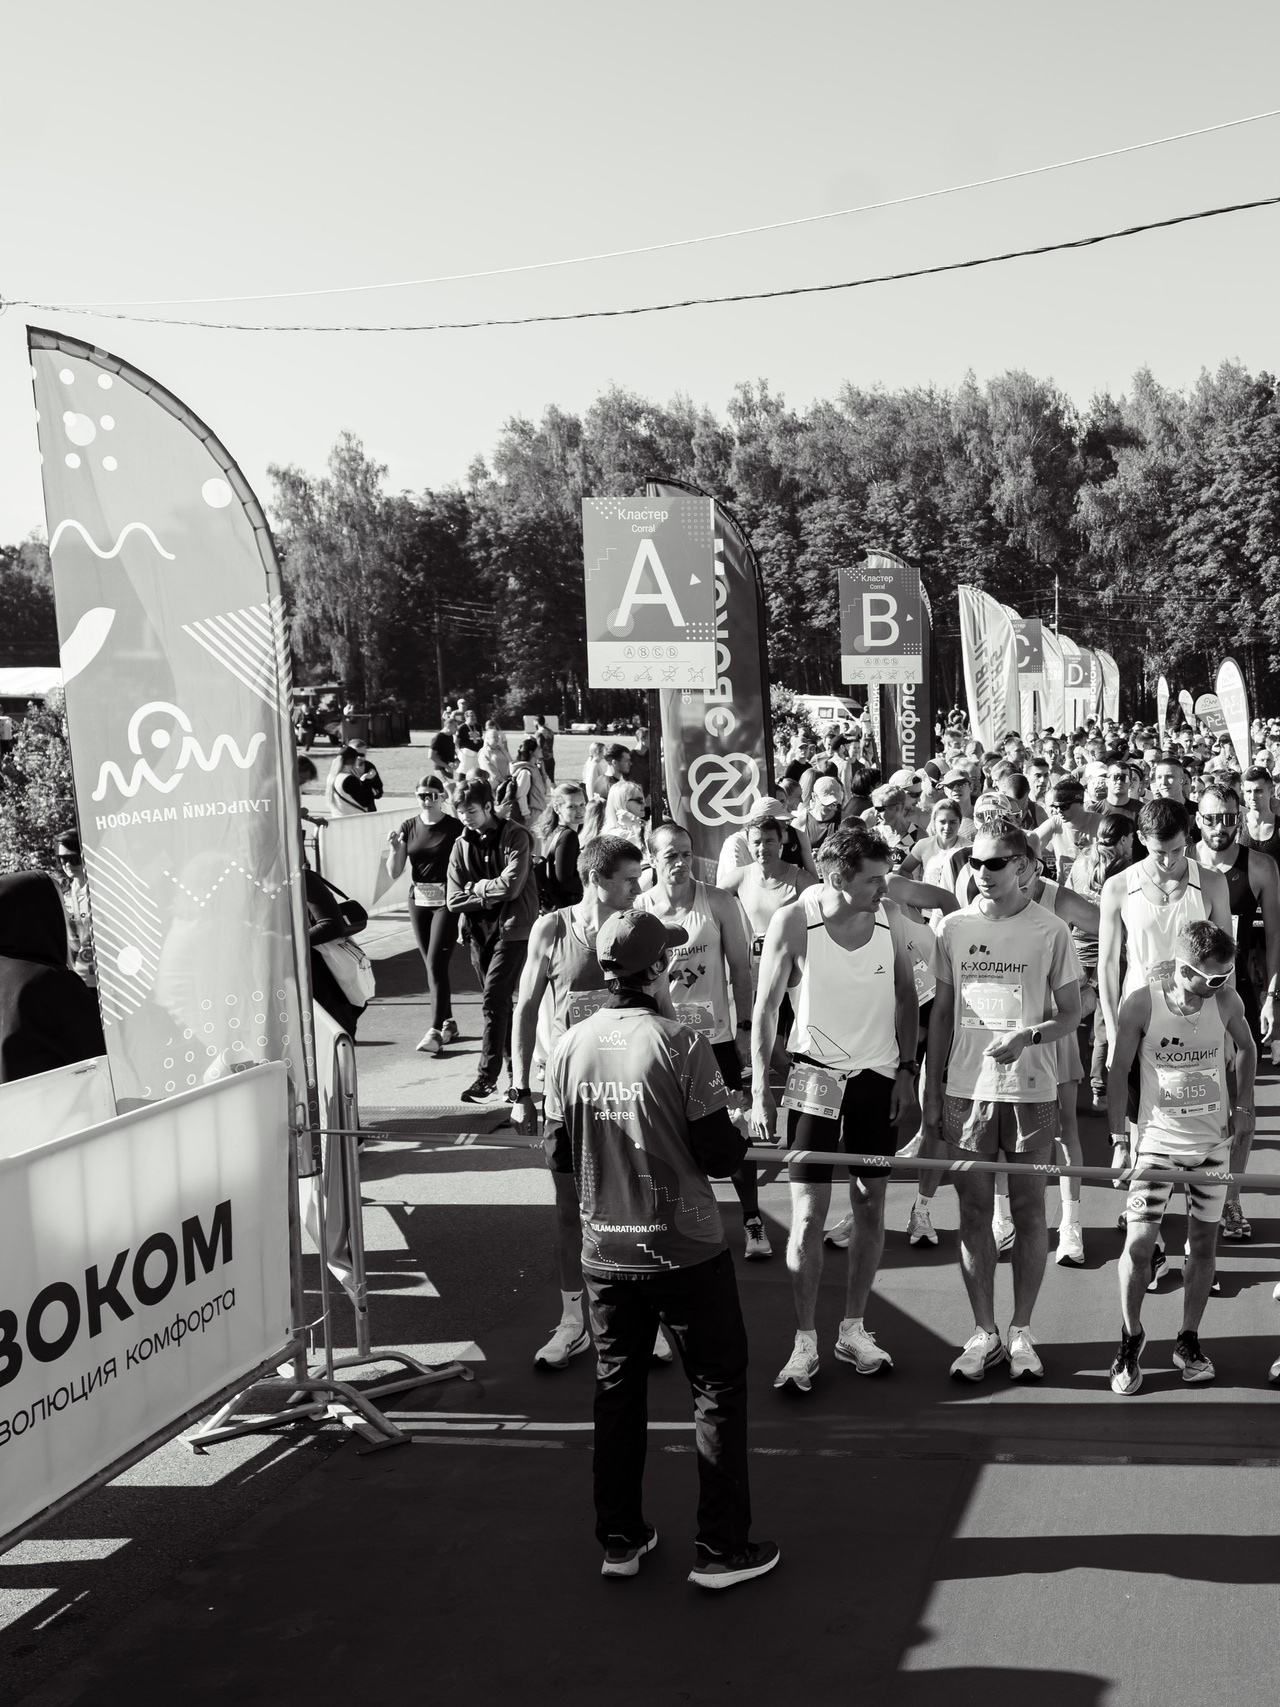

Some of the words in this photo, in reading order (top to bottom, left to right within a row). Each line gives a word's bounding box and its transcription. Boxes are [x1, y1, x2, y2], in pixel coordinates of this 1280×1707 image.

[617, 508, 669, 523] Кластер
[631, 524, 656, 533] Corral
[614, 539, 687, 627] A
[861, 574, 894, 583] Кластер
[862, 592, 900, 647] B
[1067, 663, 1084, 686] D
[668, 945, 708, 957] ОЛДИНГ
[961, 961, 1028, 974] К-ХОЛДИНГ
[977, 997, 1004, 1011] 5171
[1155, 1047, 1219, 1062] К-ХОЛДИНГ
[578, 1081, 645, 1104] СУДЬЯ
[796, 1079, 828, 1097] 5219
[1176, 1084, 1206, 1099] 5155
[594, 1108, 636, 1121] referee
[126, 1287, 237, 1370] комфорта
